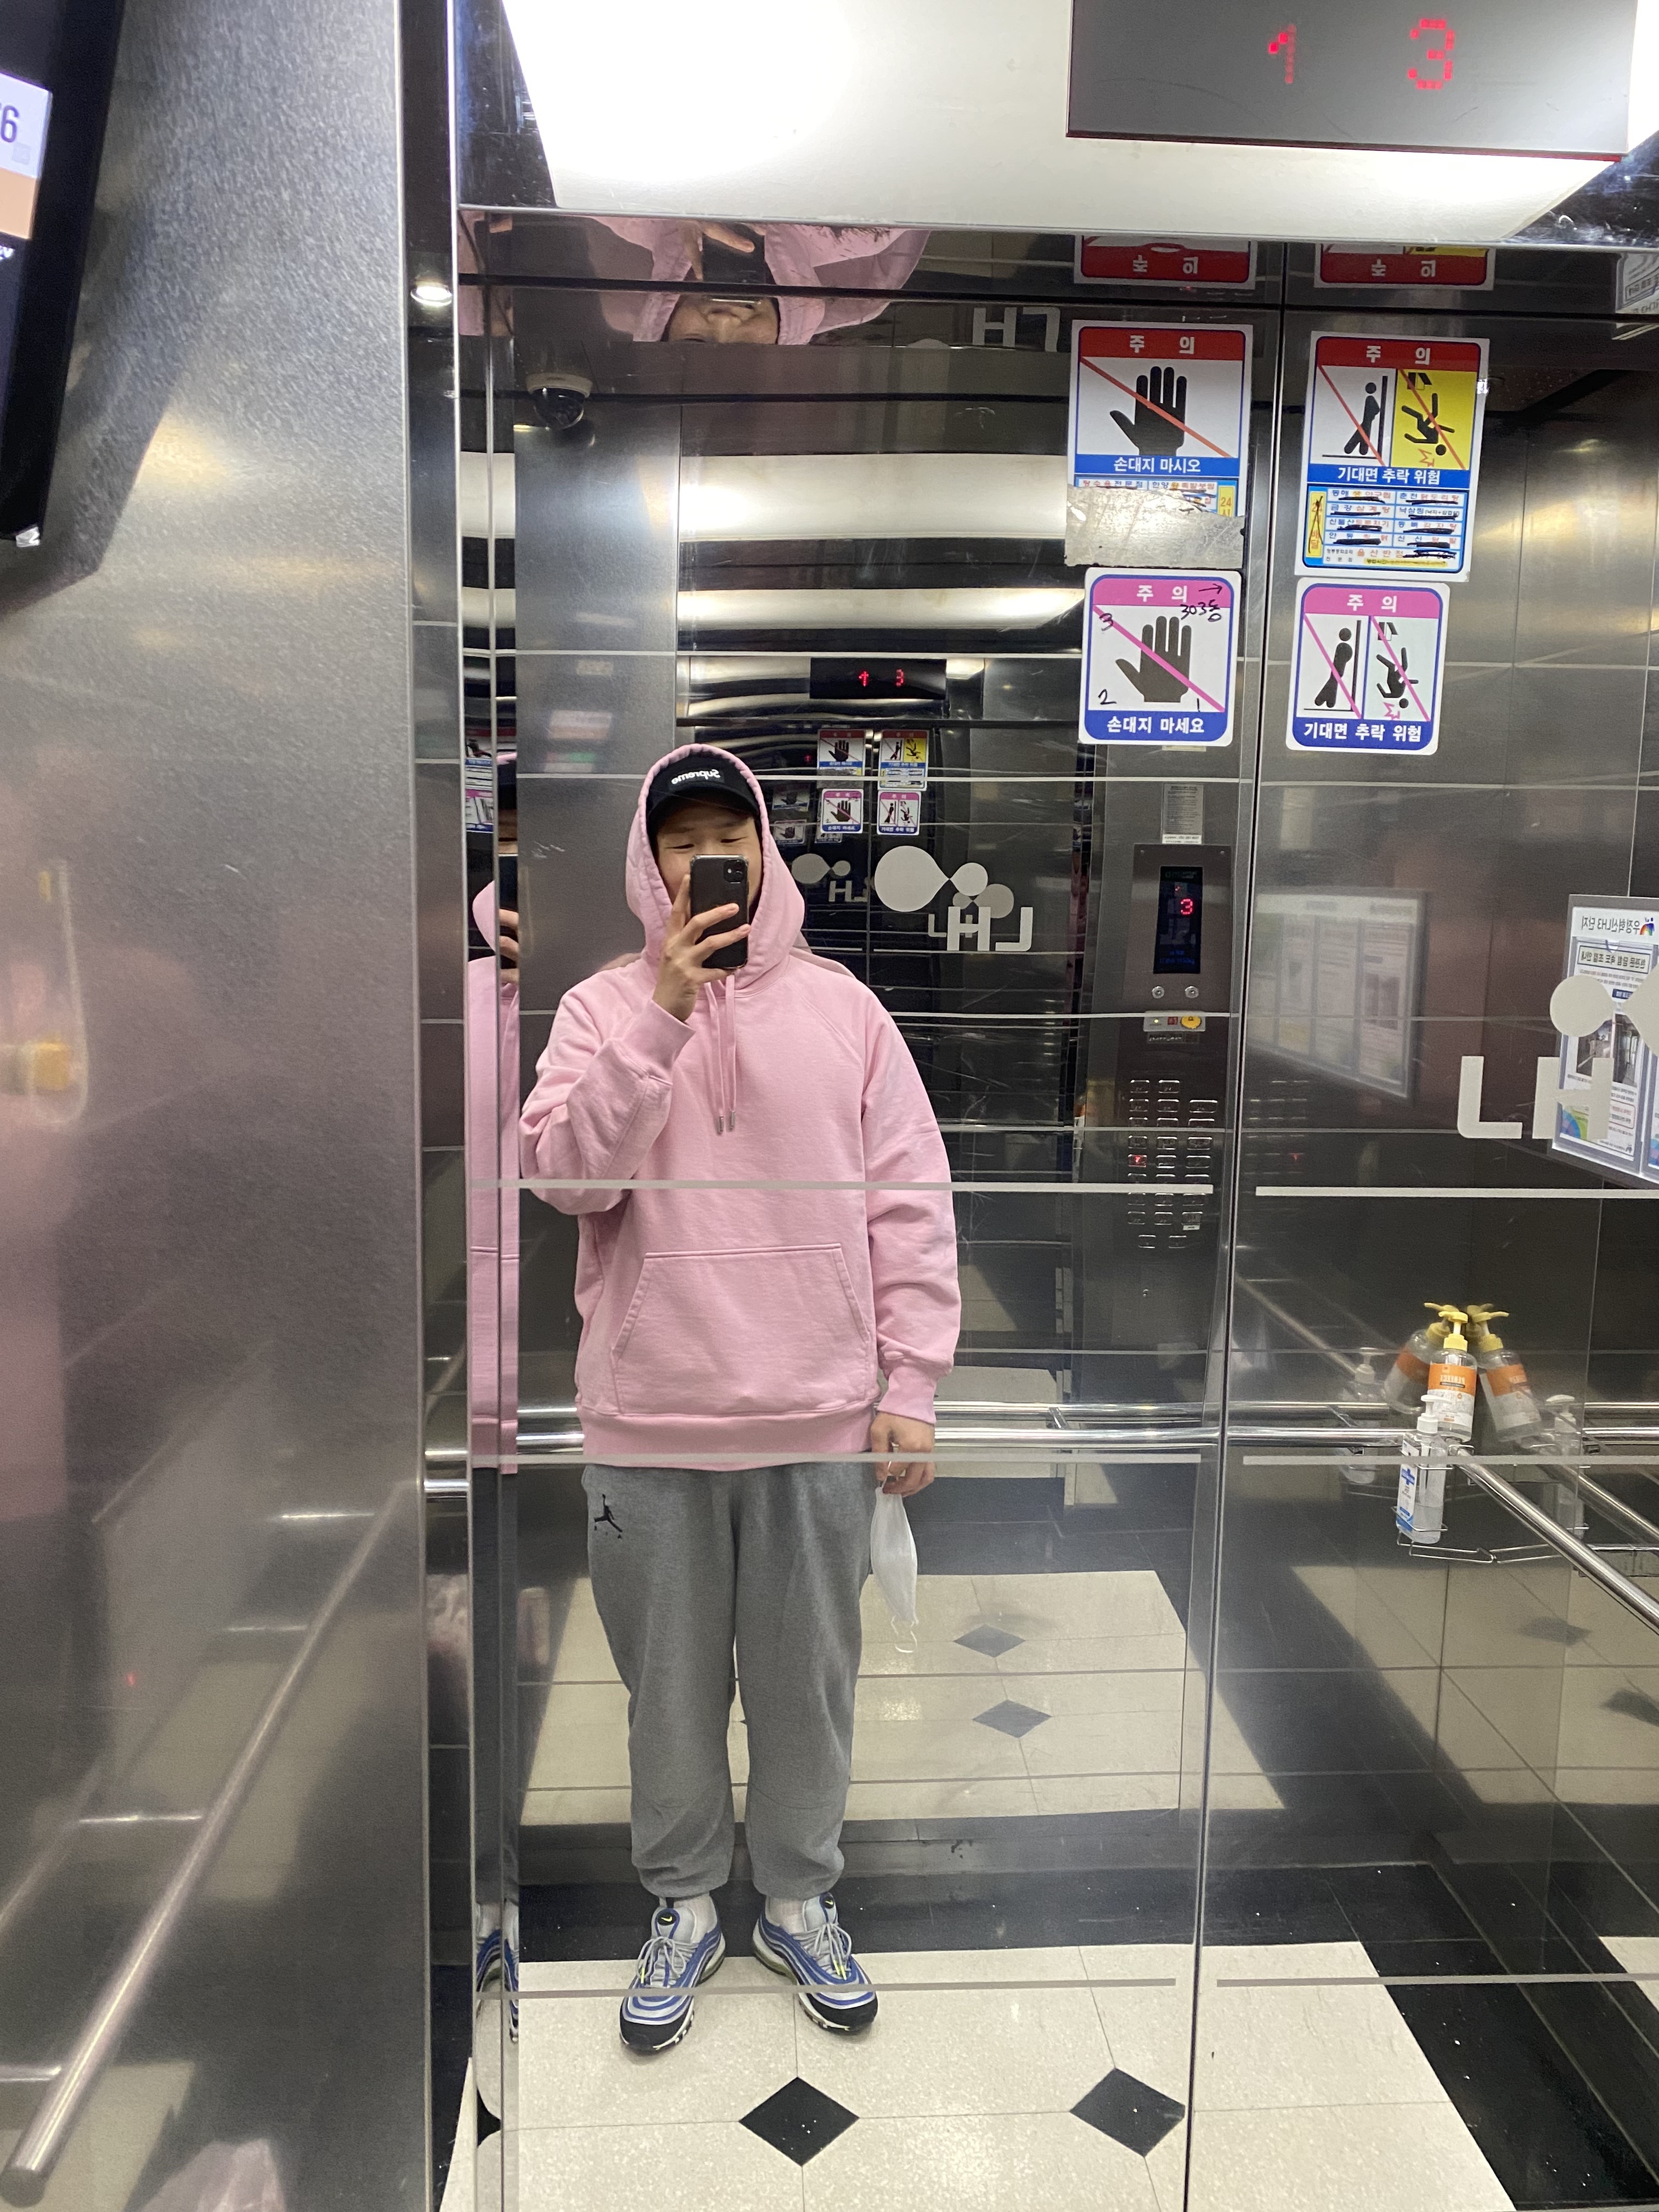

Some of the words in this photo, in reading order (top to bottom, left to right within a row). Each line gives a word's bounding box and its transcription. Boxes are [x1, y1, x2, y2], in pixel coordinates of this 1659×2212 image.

[1408, 18, 1455, 89] 3
[0, 103, 19, 144] 6
[1114, 458, 1154, 472] 손대지
[1160, 459, 1201, 473] 마시오
[1338, 467, 1378, 482] 기대면
[1382, 469, 1409, 483] 추락
[1414, 470, 1440, 485] 위험
[1098, 689, 1116, 705] 2
[1107, 716, 1152, 733] 손대지
[1160, 717, 1205, 735] 마세요
[1304, 722, 1348, 739] 기대면
[1355, 724, 1385, 741] 추락
[1392, 725, 1421, 742] 위험
[1181, 898, 1193, 915] 3
[1457, 1056, 1614, 1140] LH
